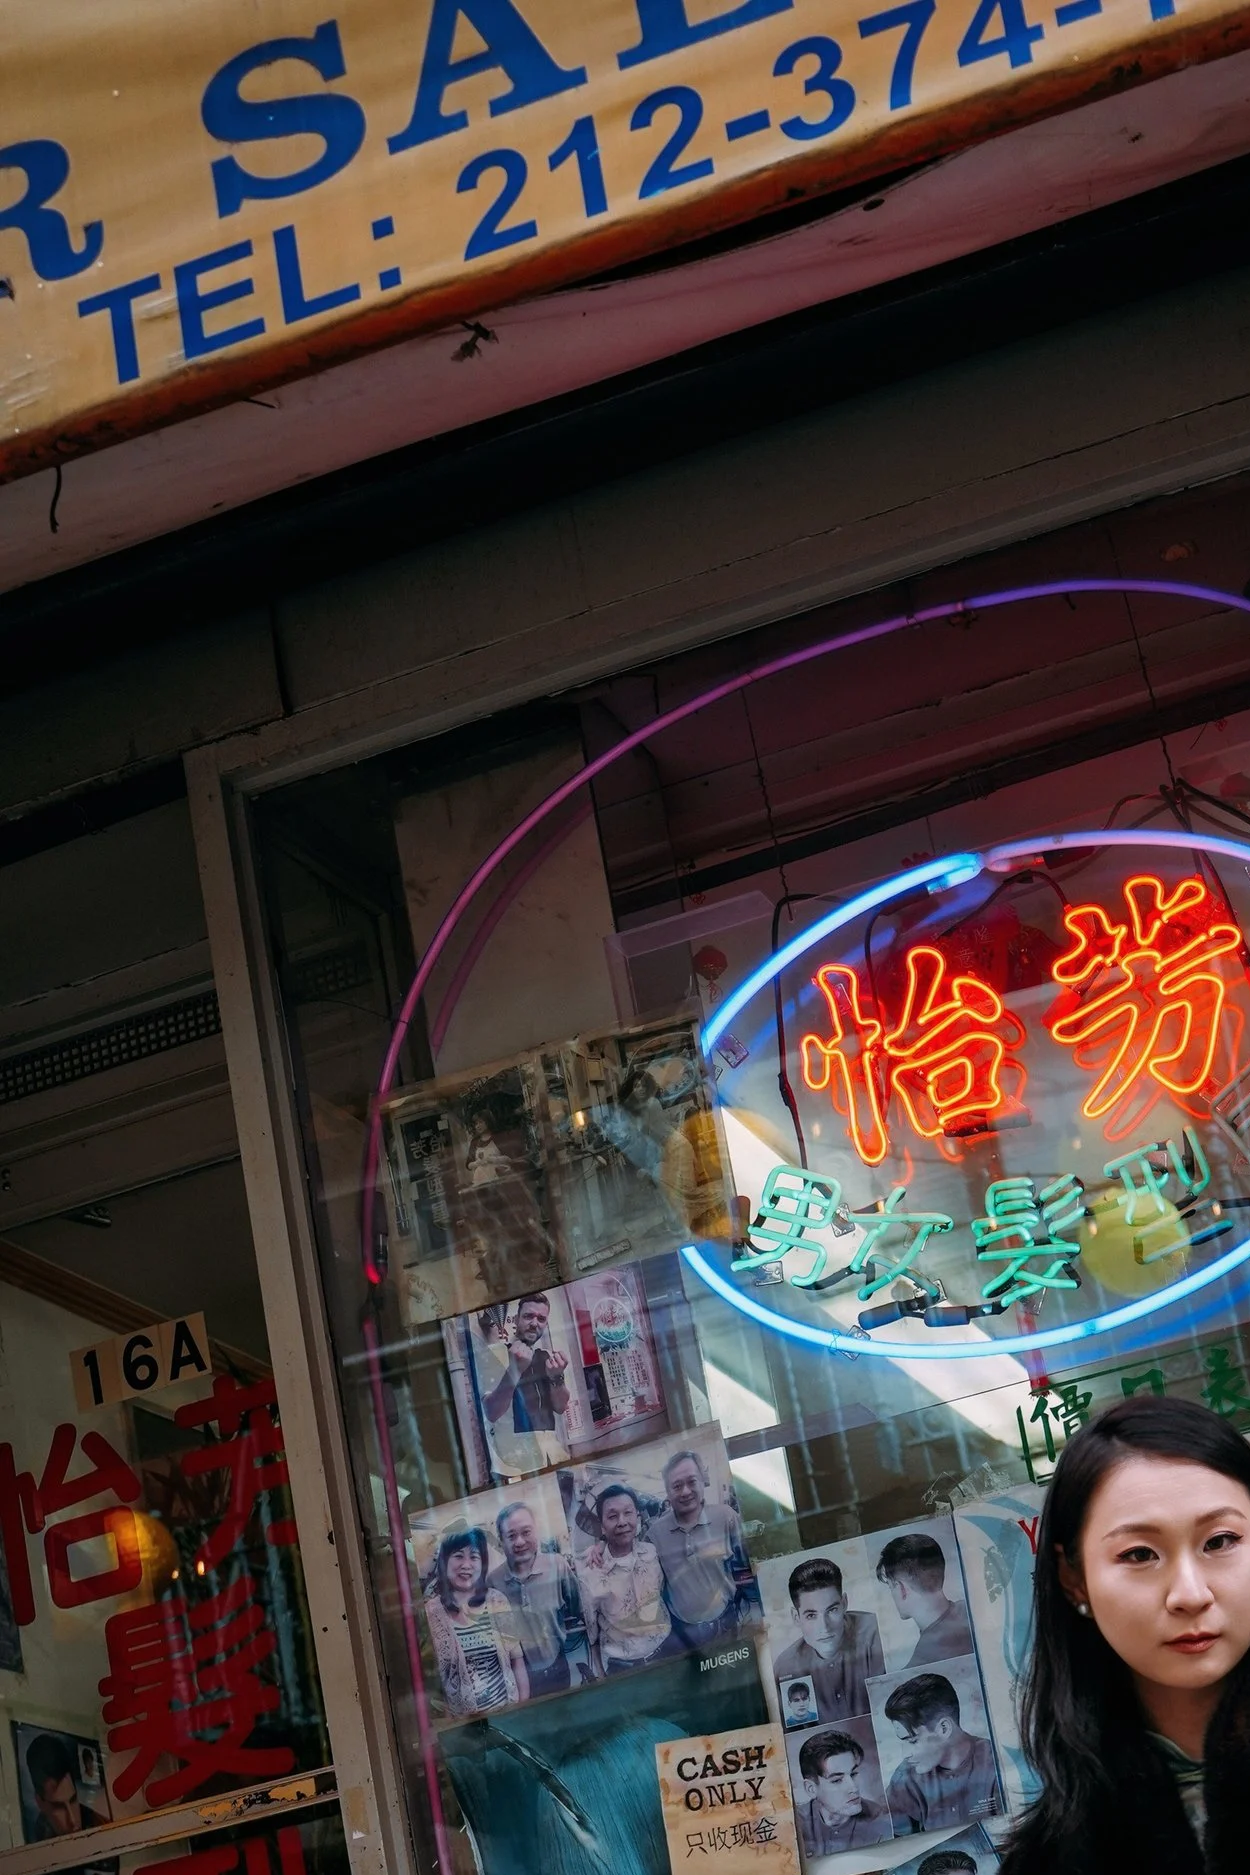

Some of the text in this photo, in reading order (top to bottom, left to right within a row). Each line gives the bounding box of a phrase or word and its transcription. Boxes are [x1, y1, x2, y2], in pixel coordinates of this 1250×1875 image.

[77, 0, 1197, 386] TEL: 212-374-
[83, 1320, 208, 1406] 16A
[700, 1646, 751, 1673] MUGENS
[676, 1744, 768, 1782] CASH
[684, 1776, 766, 1812] ONLY
[685, 1816, 778, 1858] 只收现金
